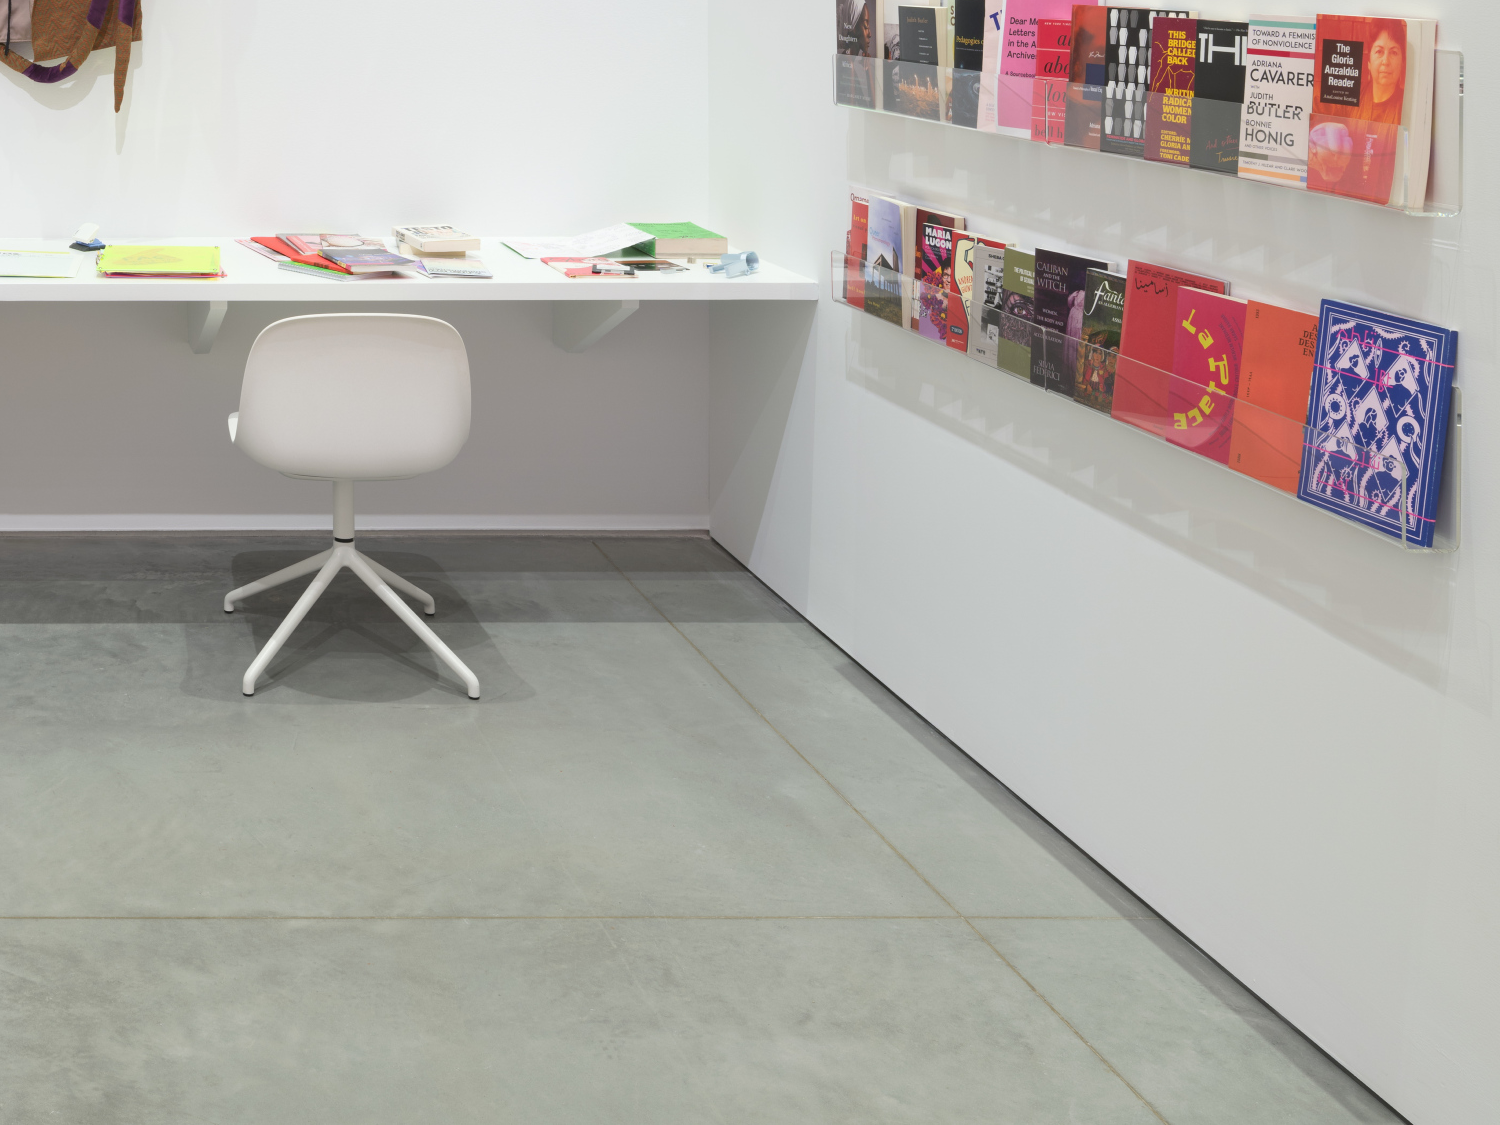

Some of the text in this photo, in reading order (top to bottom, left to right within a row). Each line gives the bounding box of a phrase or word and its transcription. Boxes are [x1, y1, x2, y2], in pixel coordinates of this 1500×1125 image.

[1010, 17, 1027, 25] Dear
[1009, 28, 1036, 37] Letters
[1168, 31, 1186, 40] THIS
[1253, 29, 1280, 38] TOWARD
[956, 36, 980, 46] Pedagogies
[1008, 39, 1015, 47] in
[1017, 40, 1029, 49] the
[1168, 39, 1196, 49] BRIDGE
[1263, 40, 1313, 50] NONVIOLENCE
[1336, 43, 1350, 53] The
[1167, 56, 1188, 66] BACK
[1252, 60, 1282, 68] ADRIANA
[1331, 54, 1354, 65] Gloria
[1324, 65, 1359, 77] Anzaldúa
[1250, 68, 1314, 87] CAVARER
[1328, 76, 1355, 88] Reader
[1250, 91, 1274, 100] JUDITH
[1247, 101, 1303, 121] BUTLER
[1161, 114, 1187, 124] COLOR
[1245, 119, 1272, 128] BONNIE
[1244, 127, 1295, 147] HONIG
[1160, 141, 1180, 150] GLORIA
[1173, 154, 1190, 162] CADE
[925, 227, 952, 240] MARIA
[925, 236, 952, 250] LUGON
[1037, 261, 1069, 276] CALIBAN
[1037, 277, 1067, 293] WITCH
[1298, 337, 1315, 349] DES
[1302, 347, 1315, 358] EN
[1038, 359, 1055, 371] SILVIA
[1033, 366, 1061, 381] FEDERICI
